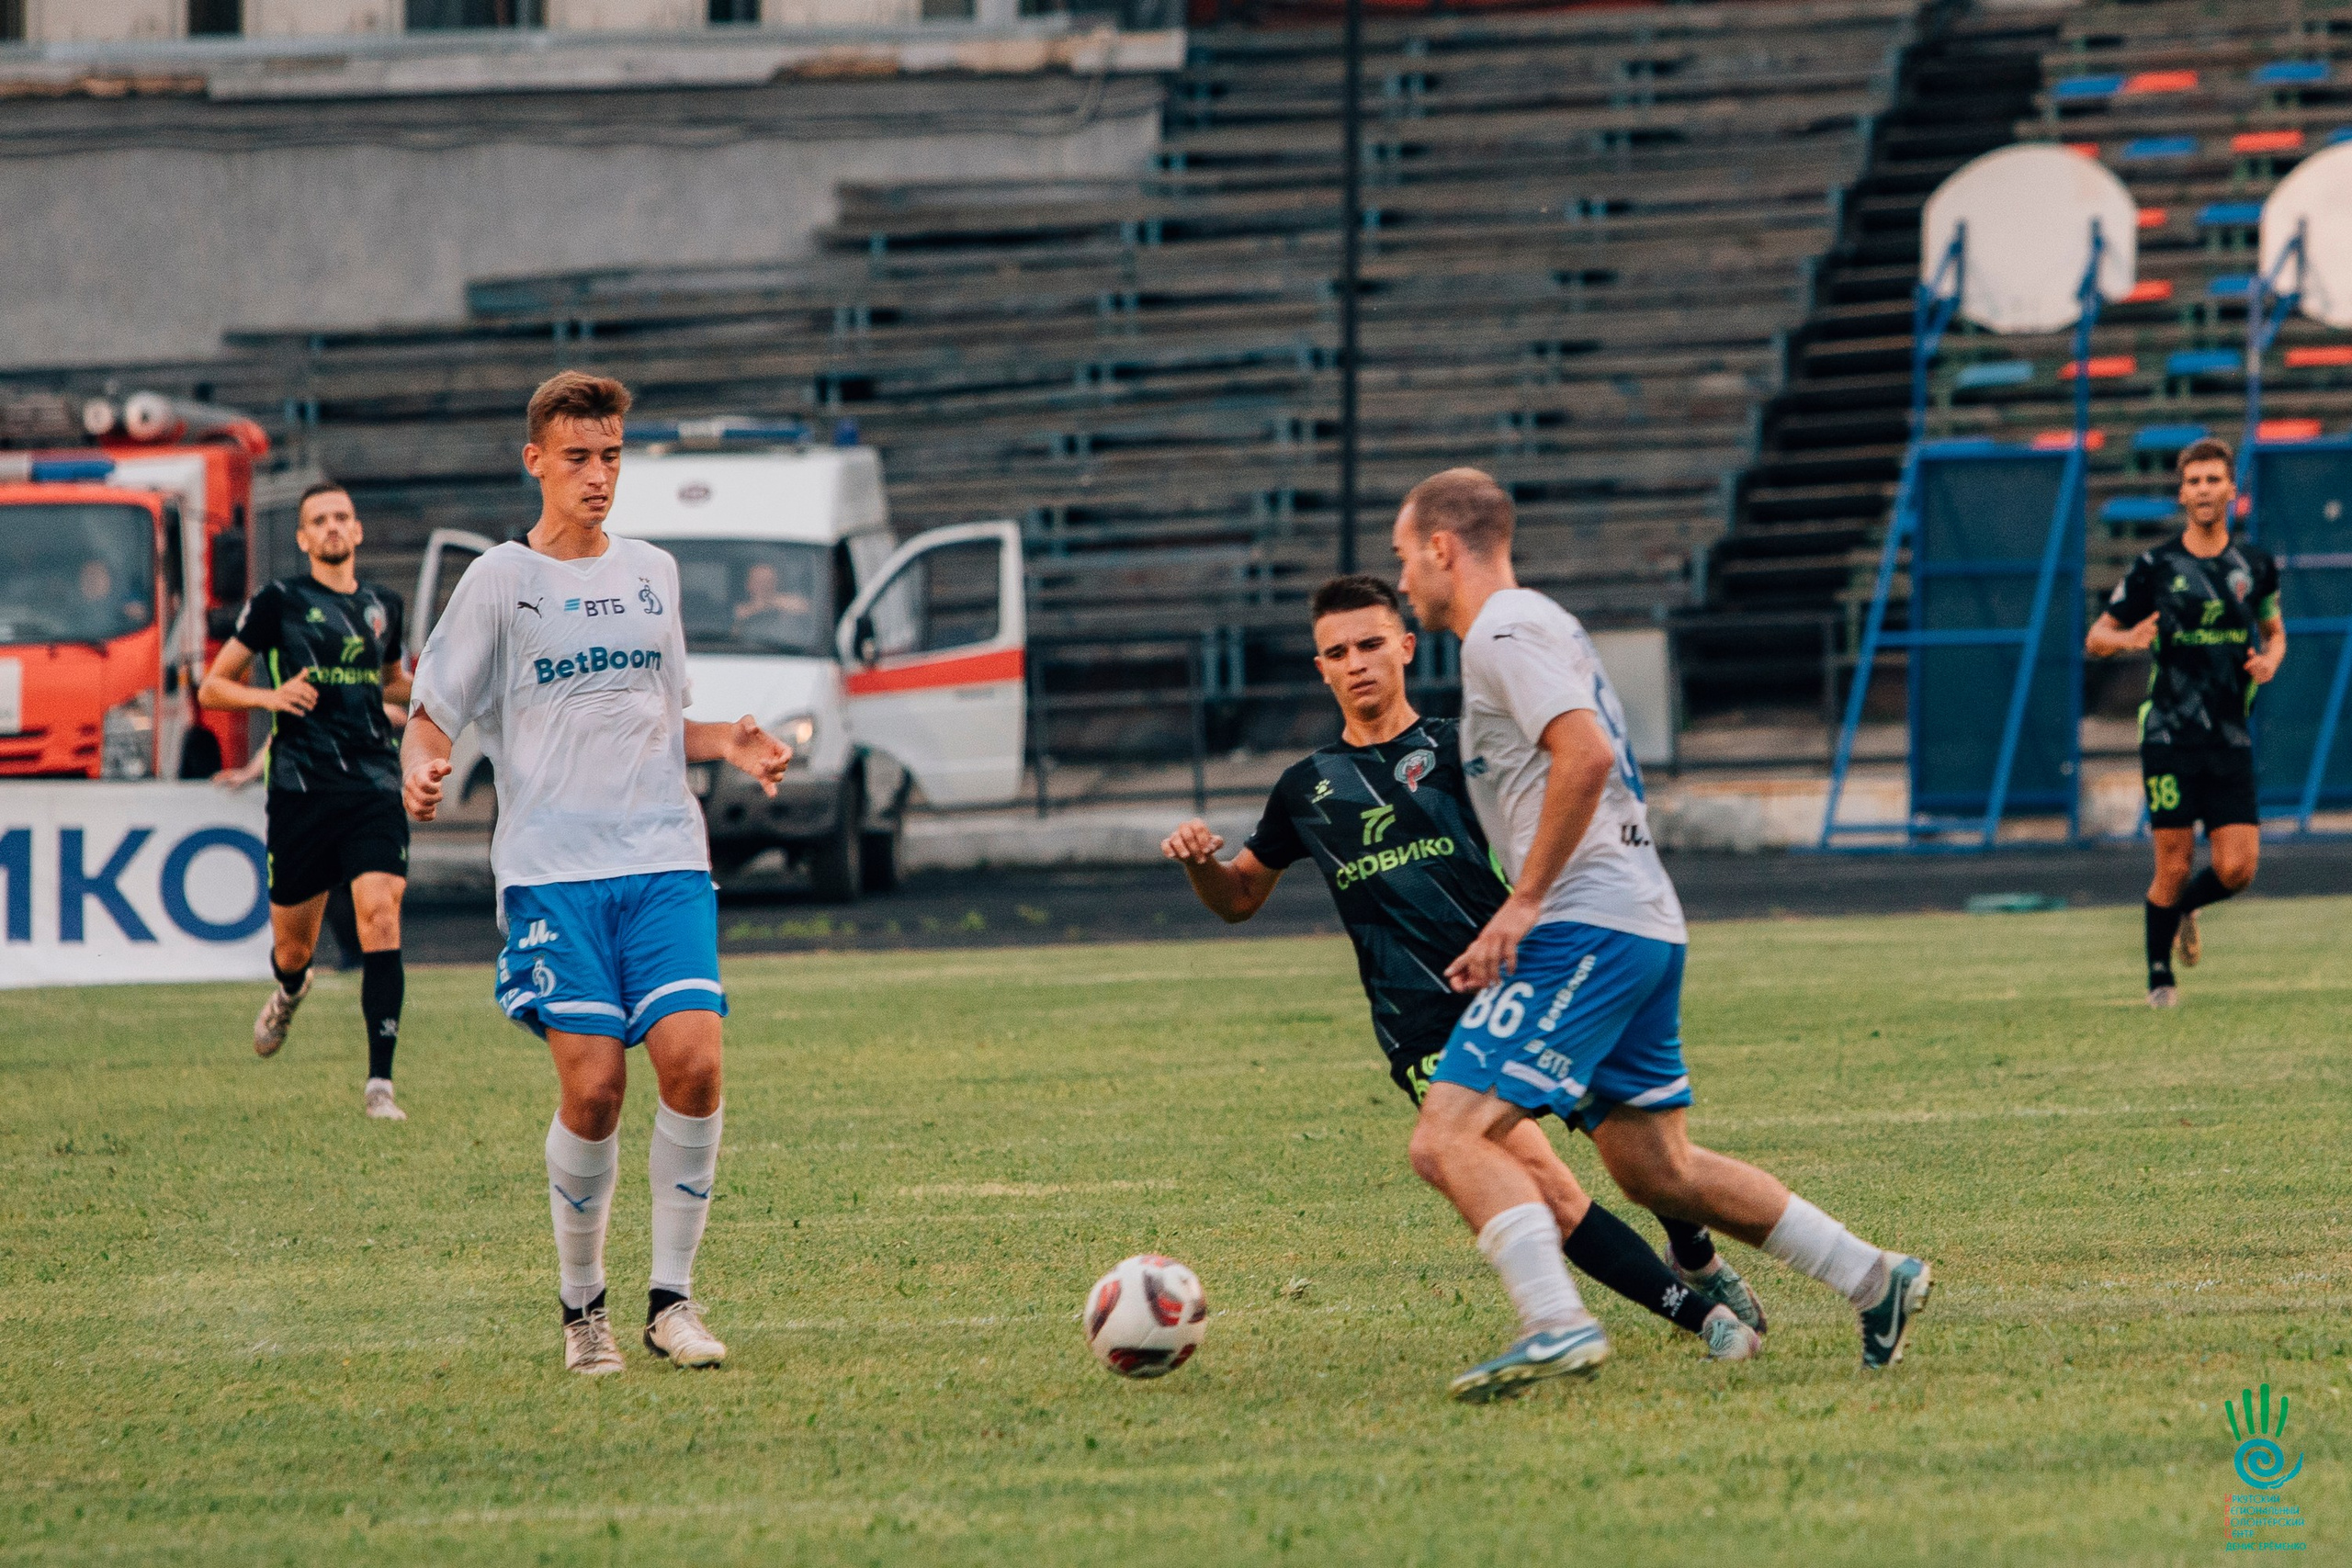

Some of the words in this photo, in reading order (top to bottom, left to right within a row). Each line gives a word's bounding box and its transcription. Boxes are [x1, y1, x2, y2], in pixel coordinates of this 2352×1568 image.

[583, 598, 626, 617] ВТБ
[534, 646, 662, 685] BetBoom
[1536, 1048, 1574, 1080] ВТБ
